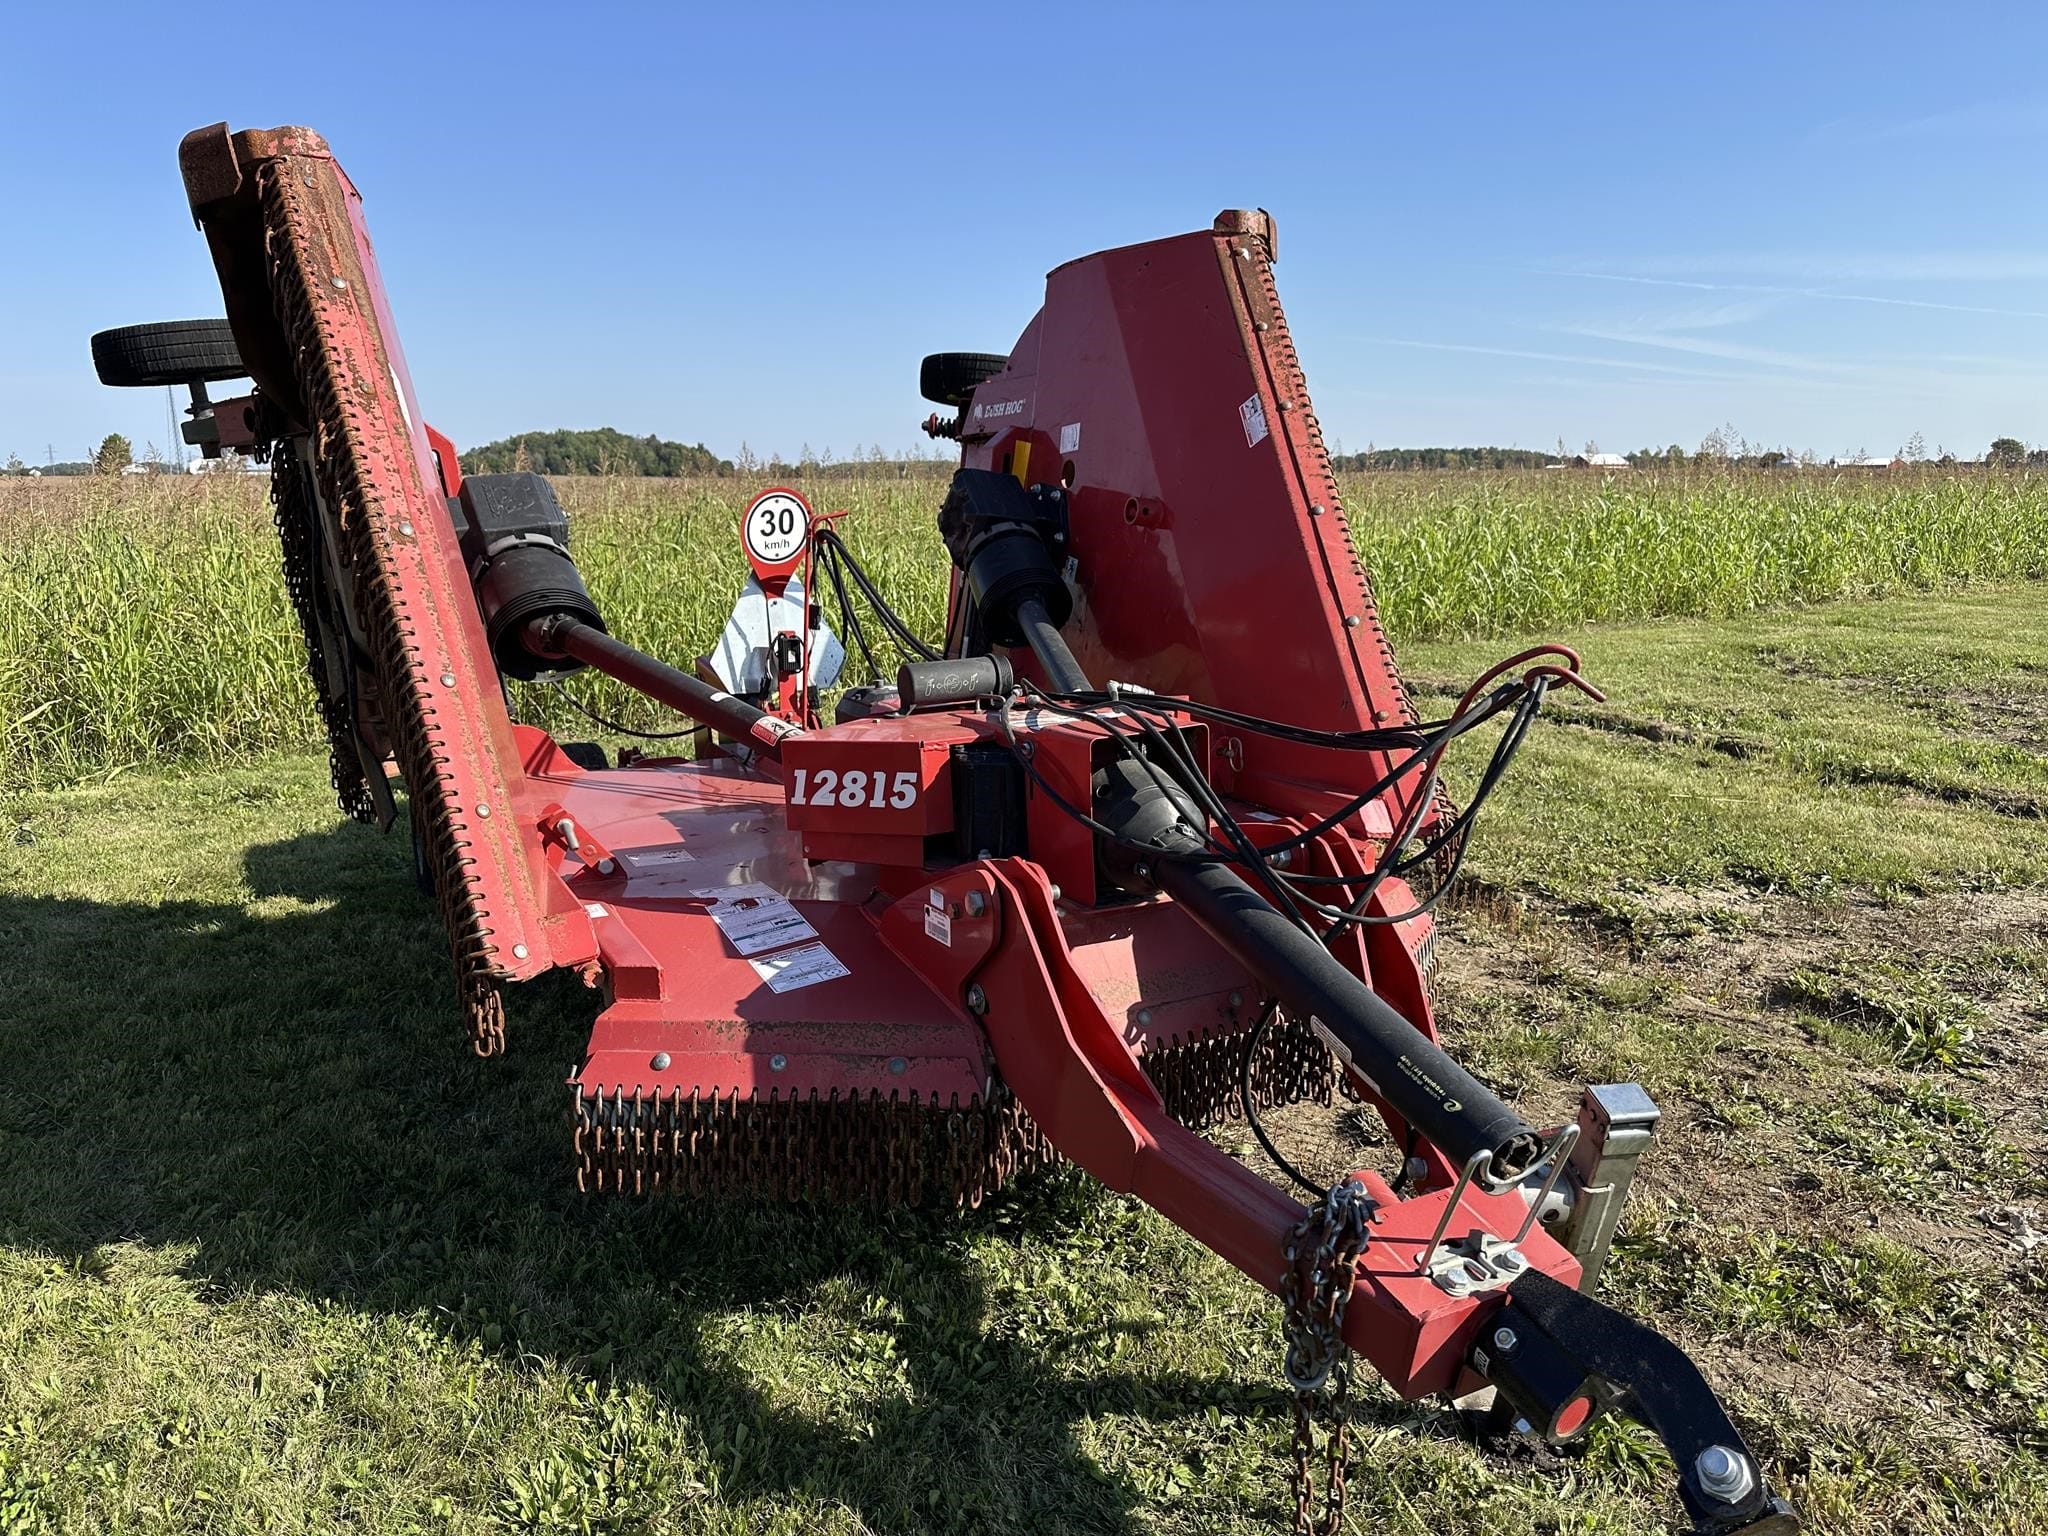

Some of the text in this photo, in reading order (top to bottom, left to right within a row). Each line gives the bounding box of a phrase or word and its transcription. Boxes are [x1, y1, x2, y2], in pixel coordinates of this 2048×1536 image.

[1005, 399, 1023, 415] HOG
[760, 508, 794, 537] 30
[764, 539, 790, 550] km/h
[790, 769, 918, 809] 12815
